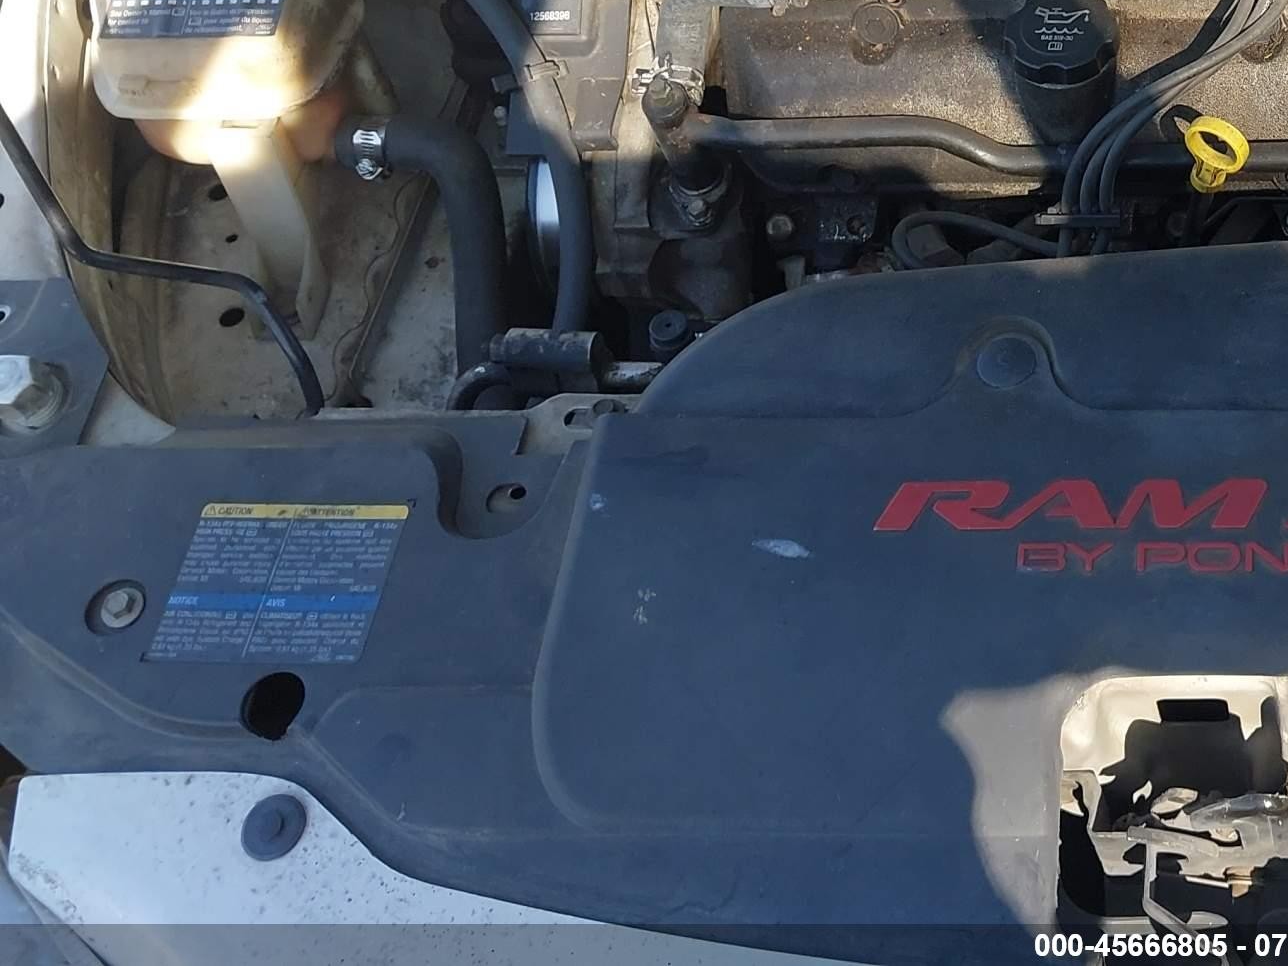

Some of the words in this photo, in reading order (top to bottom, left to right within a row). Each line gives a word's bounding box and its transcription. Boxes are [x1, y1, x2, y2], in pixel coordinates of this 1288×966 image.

[873, 478, 1268, 532] RAM
[217, 507, 254, 516] CAUTION
[1017, 542, 1114, 573] BY
[168, 595, 199, 605] NOTICE
[265, 598, 287, 607] AVIS
